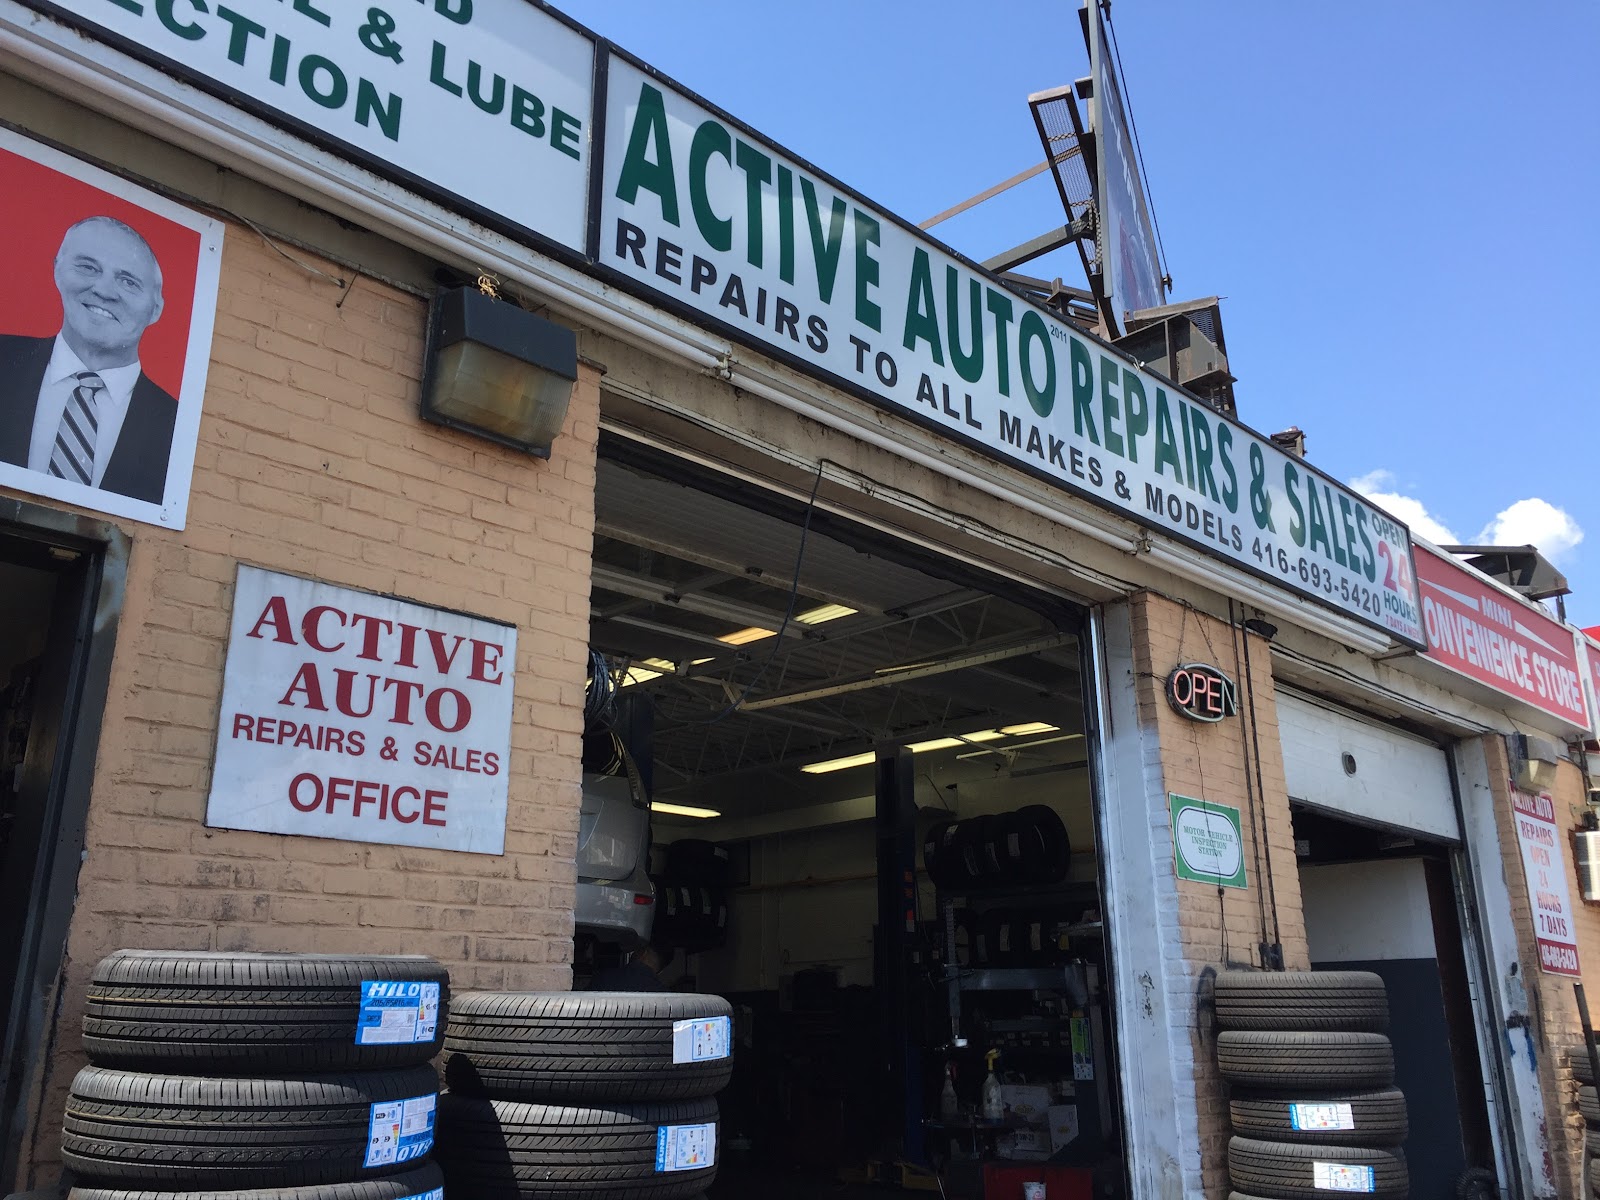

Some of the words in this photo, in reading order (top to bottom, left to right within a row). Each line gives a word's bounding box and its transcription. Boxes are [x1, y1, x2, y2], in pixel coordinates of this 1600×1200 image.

[101, 0, 403, 143] CTION
[430, 41, 582, 160] LUBE
[615, 82, 881, 333] ACTIVE
[903, 247, 1056, 418] AUTO
[1070, 336, 1238, 514] REPAIRS
[1250, 442, 1276, 534] &
[1285, 461, 1377, 584] SALES
[1050, 324, 1067, 344] 2011
[616, 218, 828, 354] REPAIRS
[850, 335, 898, 388] TO
[916, 373, 982, 430] ALL
[1000, 409, 1104, 487] MAKES
[1114, 469, 1131, 501] &
[1144, 482, 1243, 552] MODELS
[1252, 537, 1381, 617] 416-693-5420
[1371, 513, 1407, 552] OPEN
[1378, 540, 1413, 602] 24
[1383, 590, 1417, 625] HOURS
[1481, 595, 1512, 630] MINI
[246, 596, 504, 685] ACTIVE
[1424, 595, 1535, 692] ONVENIENCE
[1533, 651, 1582, 715] STORE
[277, 662, 472, 733] AUTO
[1173, 669, 1237, 716] OPEN
[232, 713, 366, 756] REPAIRS
[379, 736, 398, 762] &
[413, 741, 499, 776] SALES
[288, 773, 448, 827] OFFICE
[1183, 825, 1205, 838] MOTOR
[1207, 830, 1233, 843] VEHICLE
[1191, 836, 1227, 850] INSPECTION
[1198, 846, 1222, 858] STATION
[1521, 820, 1553, 848] REPAIRS
[1536, 890, 1562, 914] HOURS
[1539, 914, 1544, 932] 7
[1546, 914, 1567, 937] DAYS
[368, 982, 420, 997] HILO
[397, 1139, 432, 1161] HILO
